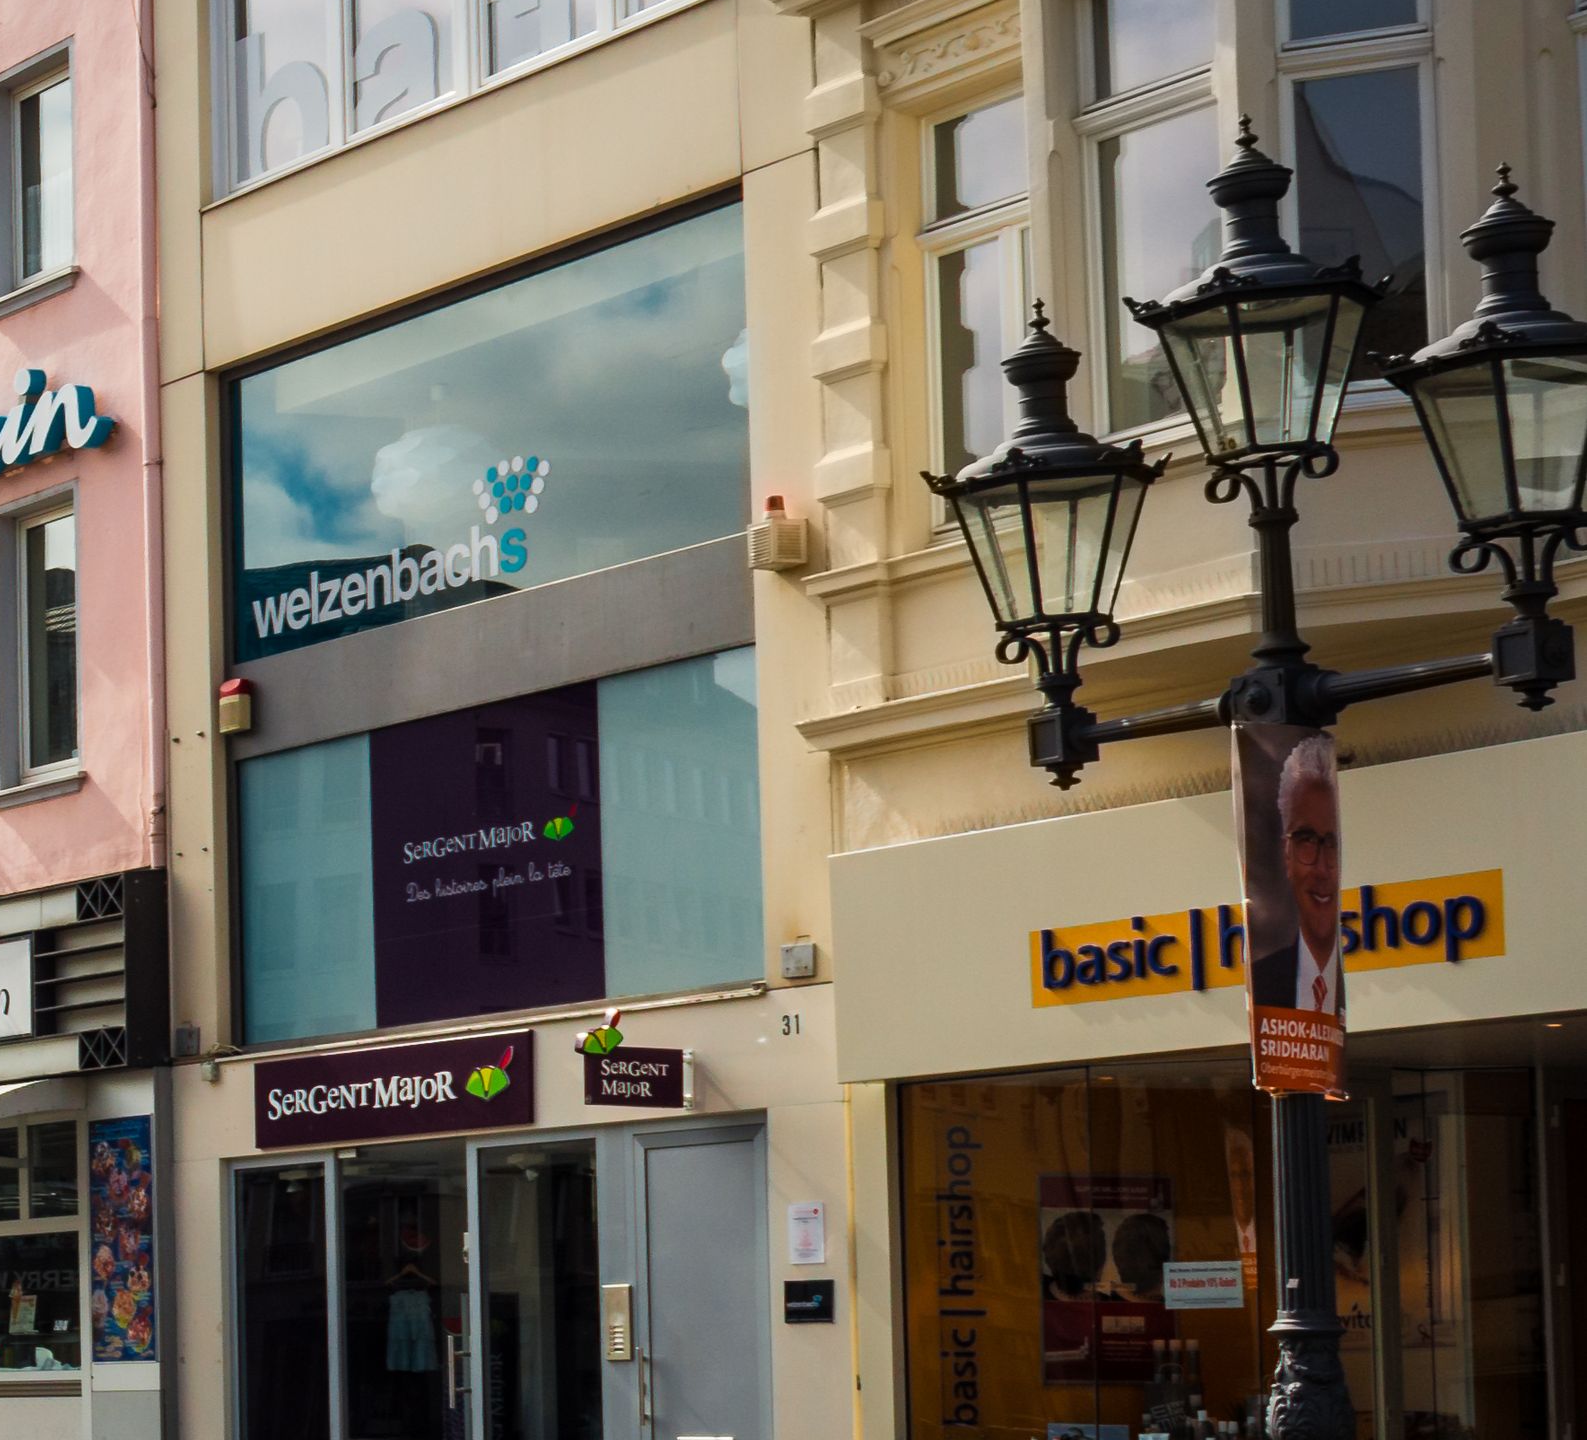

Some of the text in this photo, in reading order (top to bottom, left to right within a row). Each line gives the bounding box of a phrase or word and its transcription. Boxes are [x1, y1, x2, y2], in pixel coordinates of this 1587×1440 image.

[251, 524, 528, 639] welzenbachs
[405, 881, 432, 903] Des
[434, 877, 488, 898] histoires
[491, 866, 525, 898] plein
[527, 861, 544, 883] la
[1041, 916, 1178, 989] basic
[1219, 885, 1484, 962] hshop
[781, 1014, 800, 1036] 31
[936, 1124, 983, 1297] hairshop
[942, 1327, 979, 1428] basic
